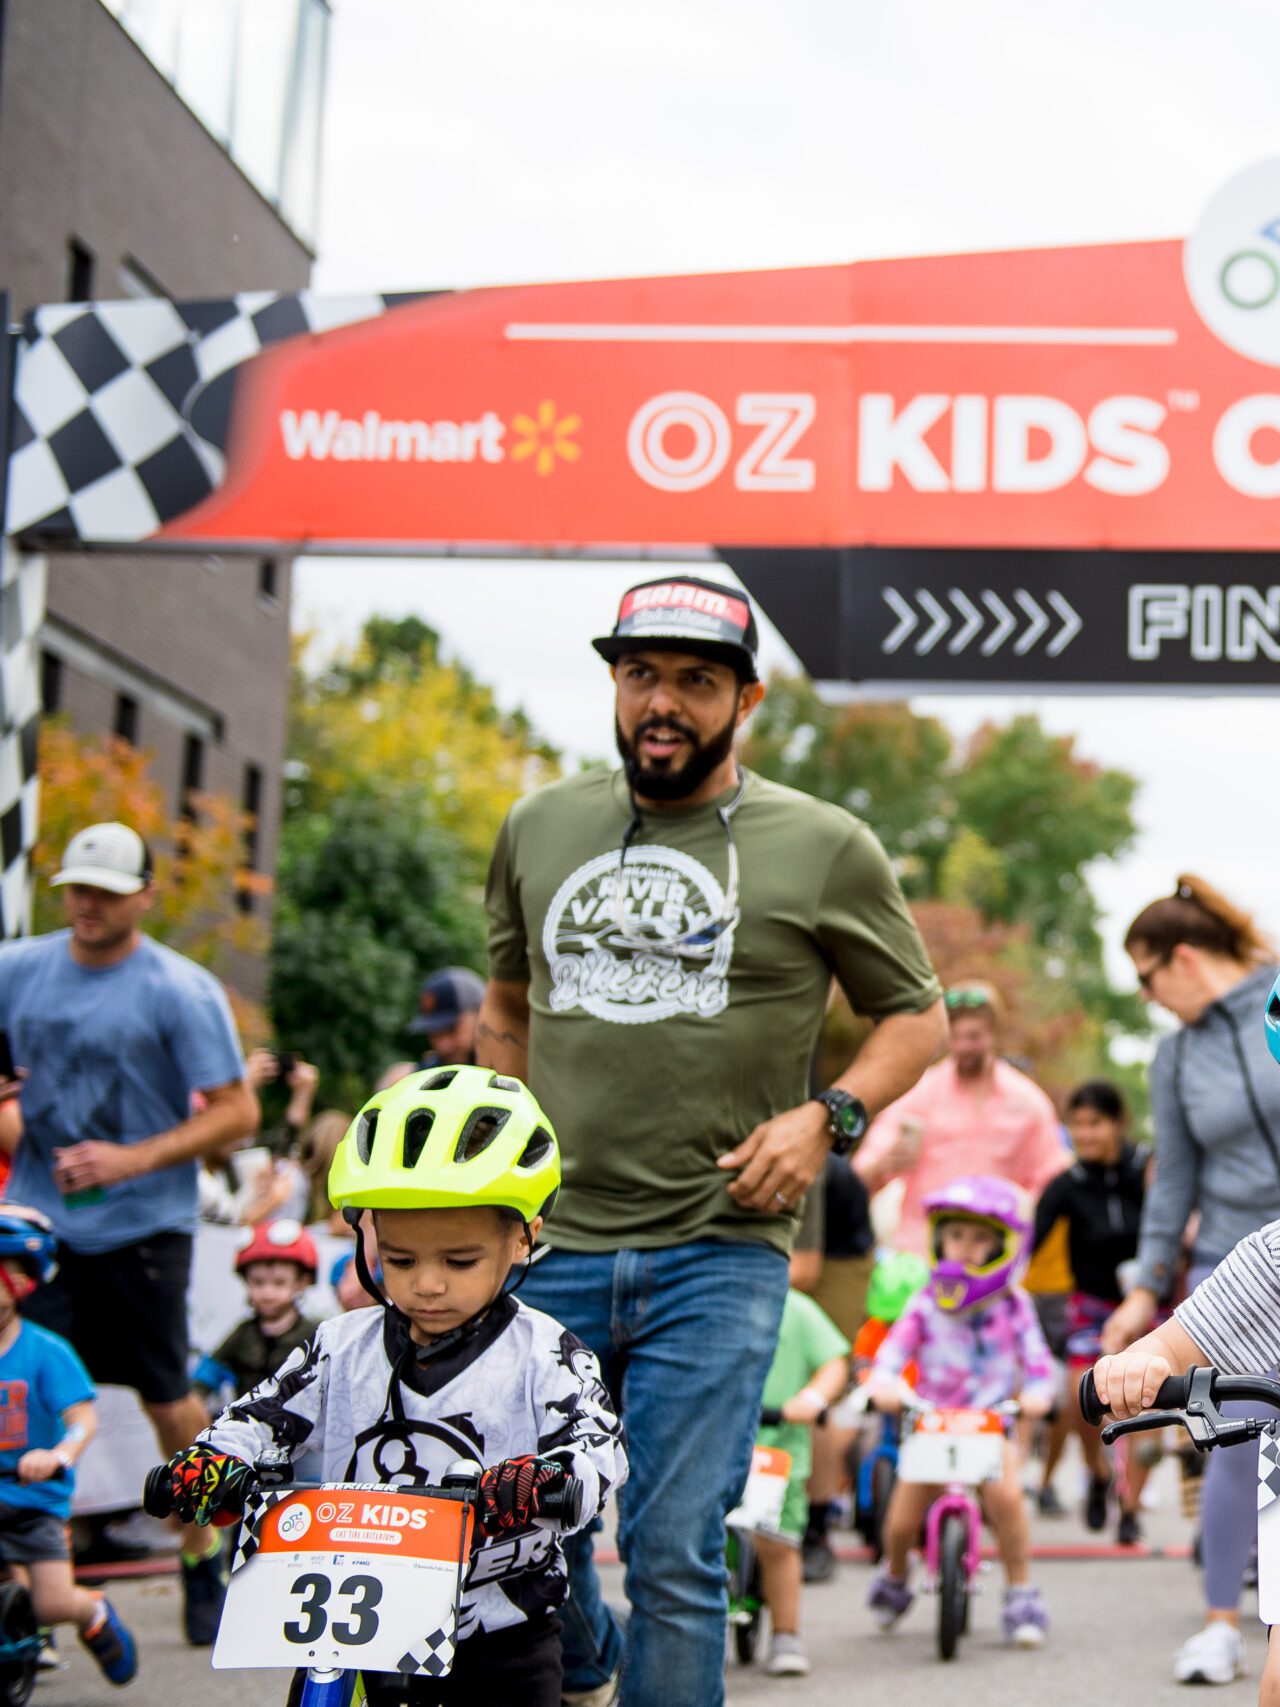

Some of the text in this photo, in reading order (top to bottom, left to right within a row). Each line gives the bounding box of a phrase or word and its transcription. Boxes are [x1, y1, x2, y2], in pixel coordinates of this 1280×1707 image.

[279, 409, 505, 463] Walmart
[627, 390, 816, 493] OZ
[598, 876, 688, 904] RIVER
[571, 897, 707, 933] VALLEY
[946, 1444, 958, 1470] 1
[319, 1481, 399, 1494] STRIDER
[316, 1502, 354, 1524] OZ
[283, 1572, 383, 1646] 33
